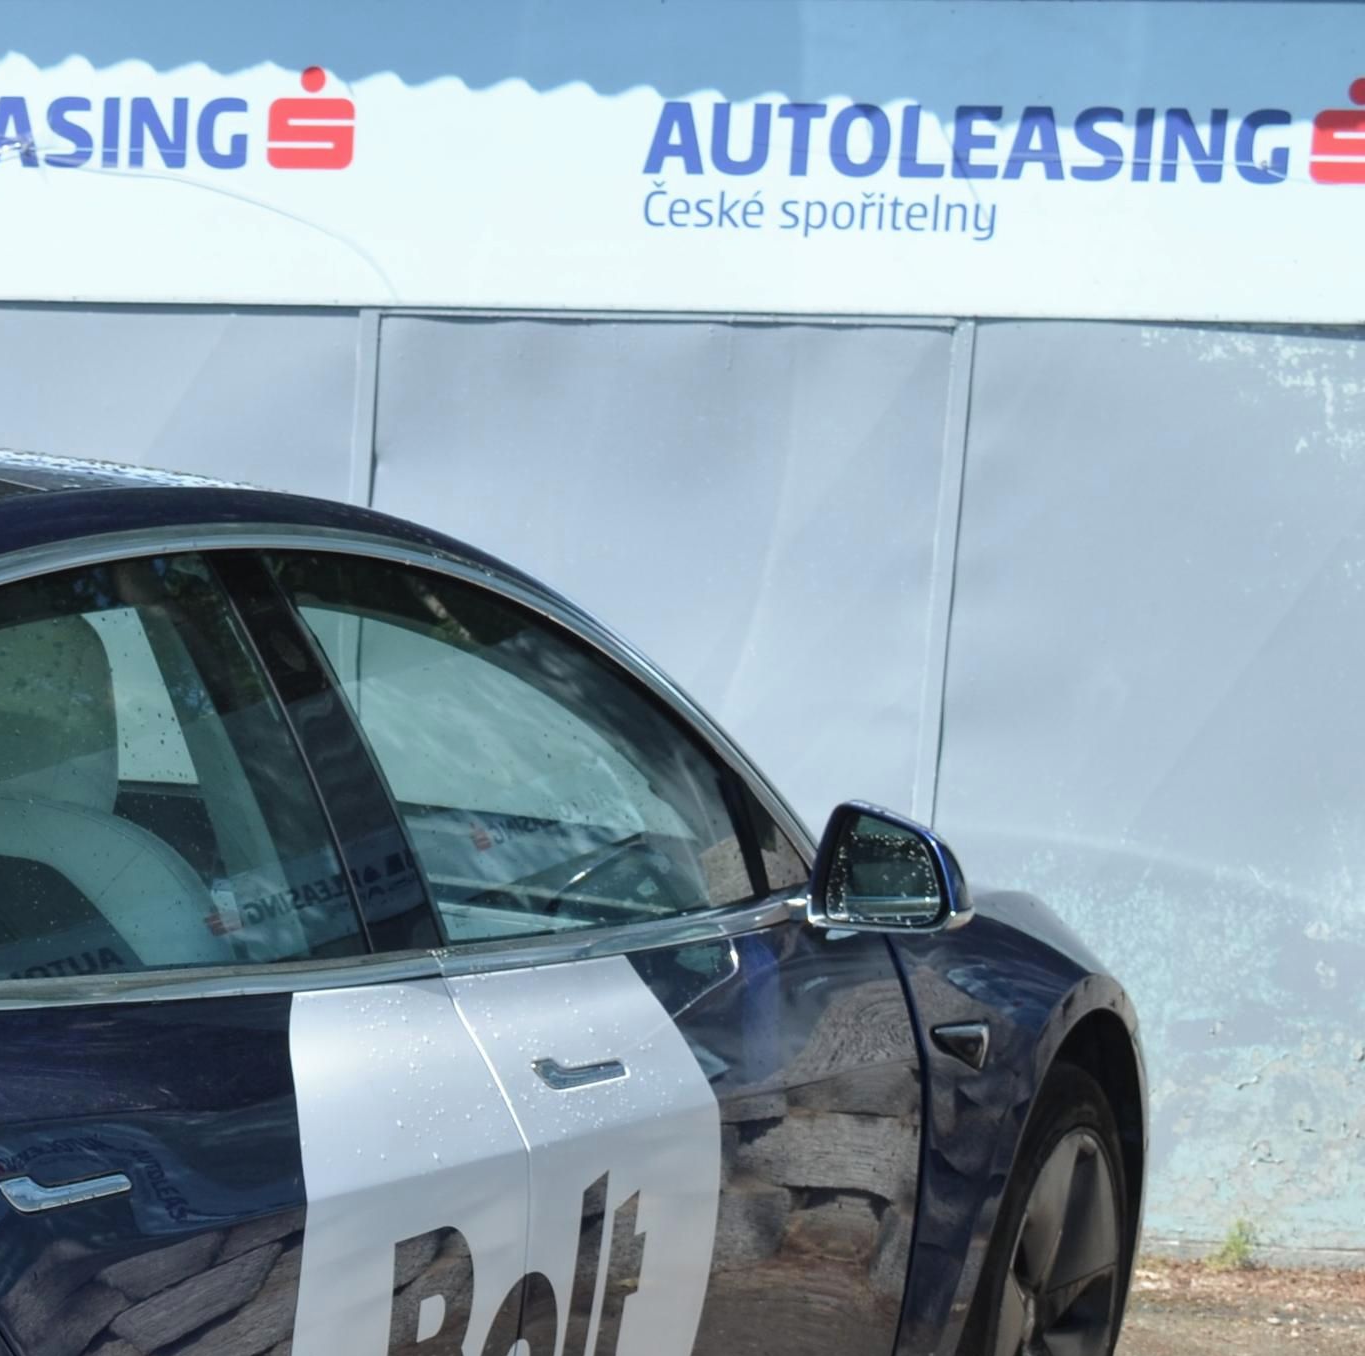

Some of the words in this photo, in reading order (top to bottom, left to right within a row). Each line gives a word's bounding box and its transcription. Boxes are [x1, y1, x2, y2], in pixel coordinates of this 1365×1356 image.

[642, 101, 1293, 185] AUTOLEASING
[642, 181, 765, 229] České
[779, 192, 997, 241] spořitelny
